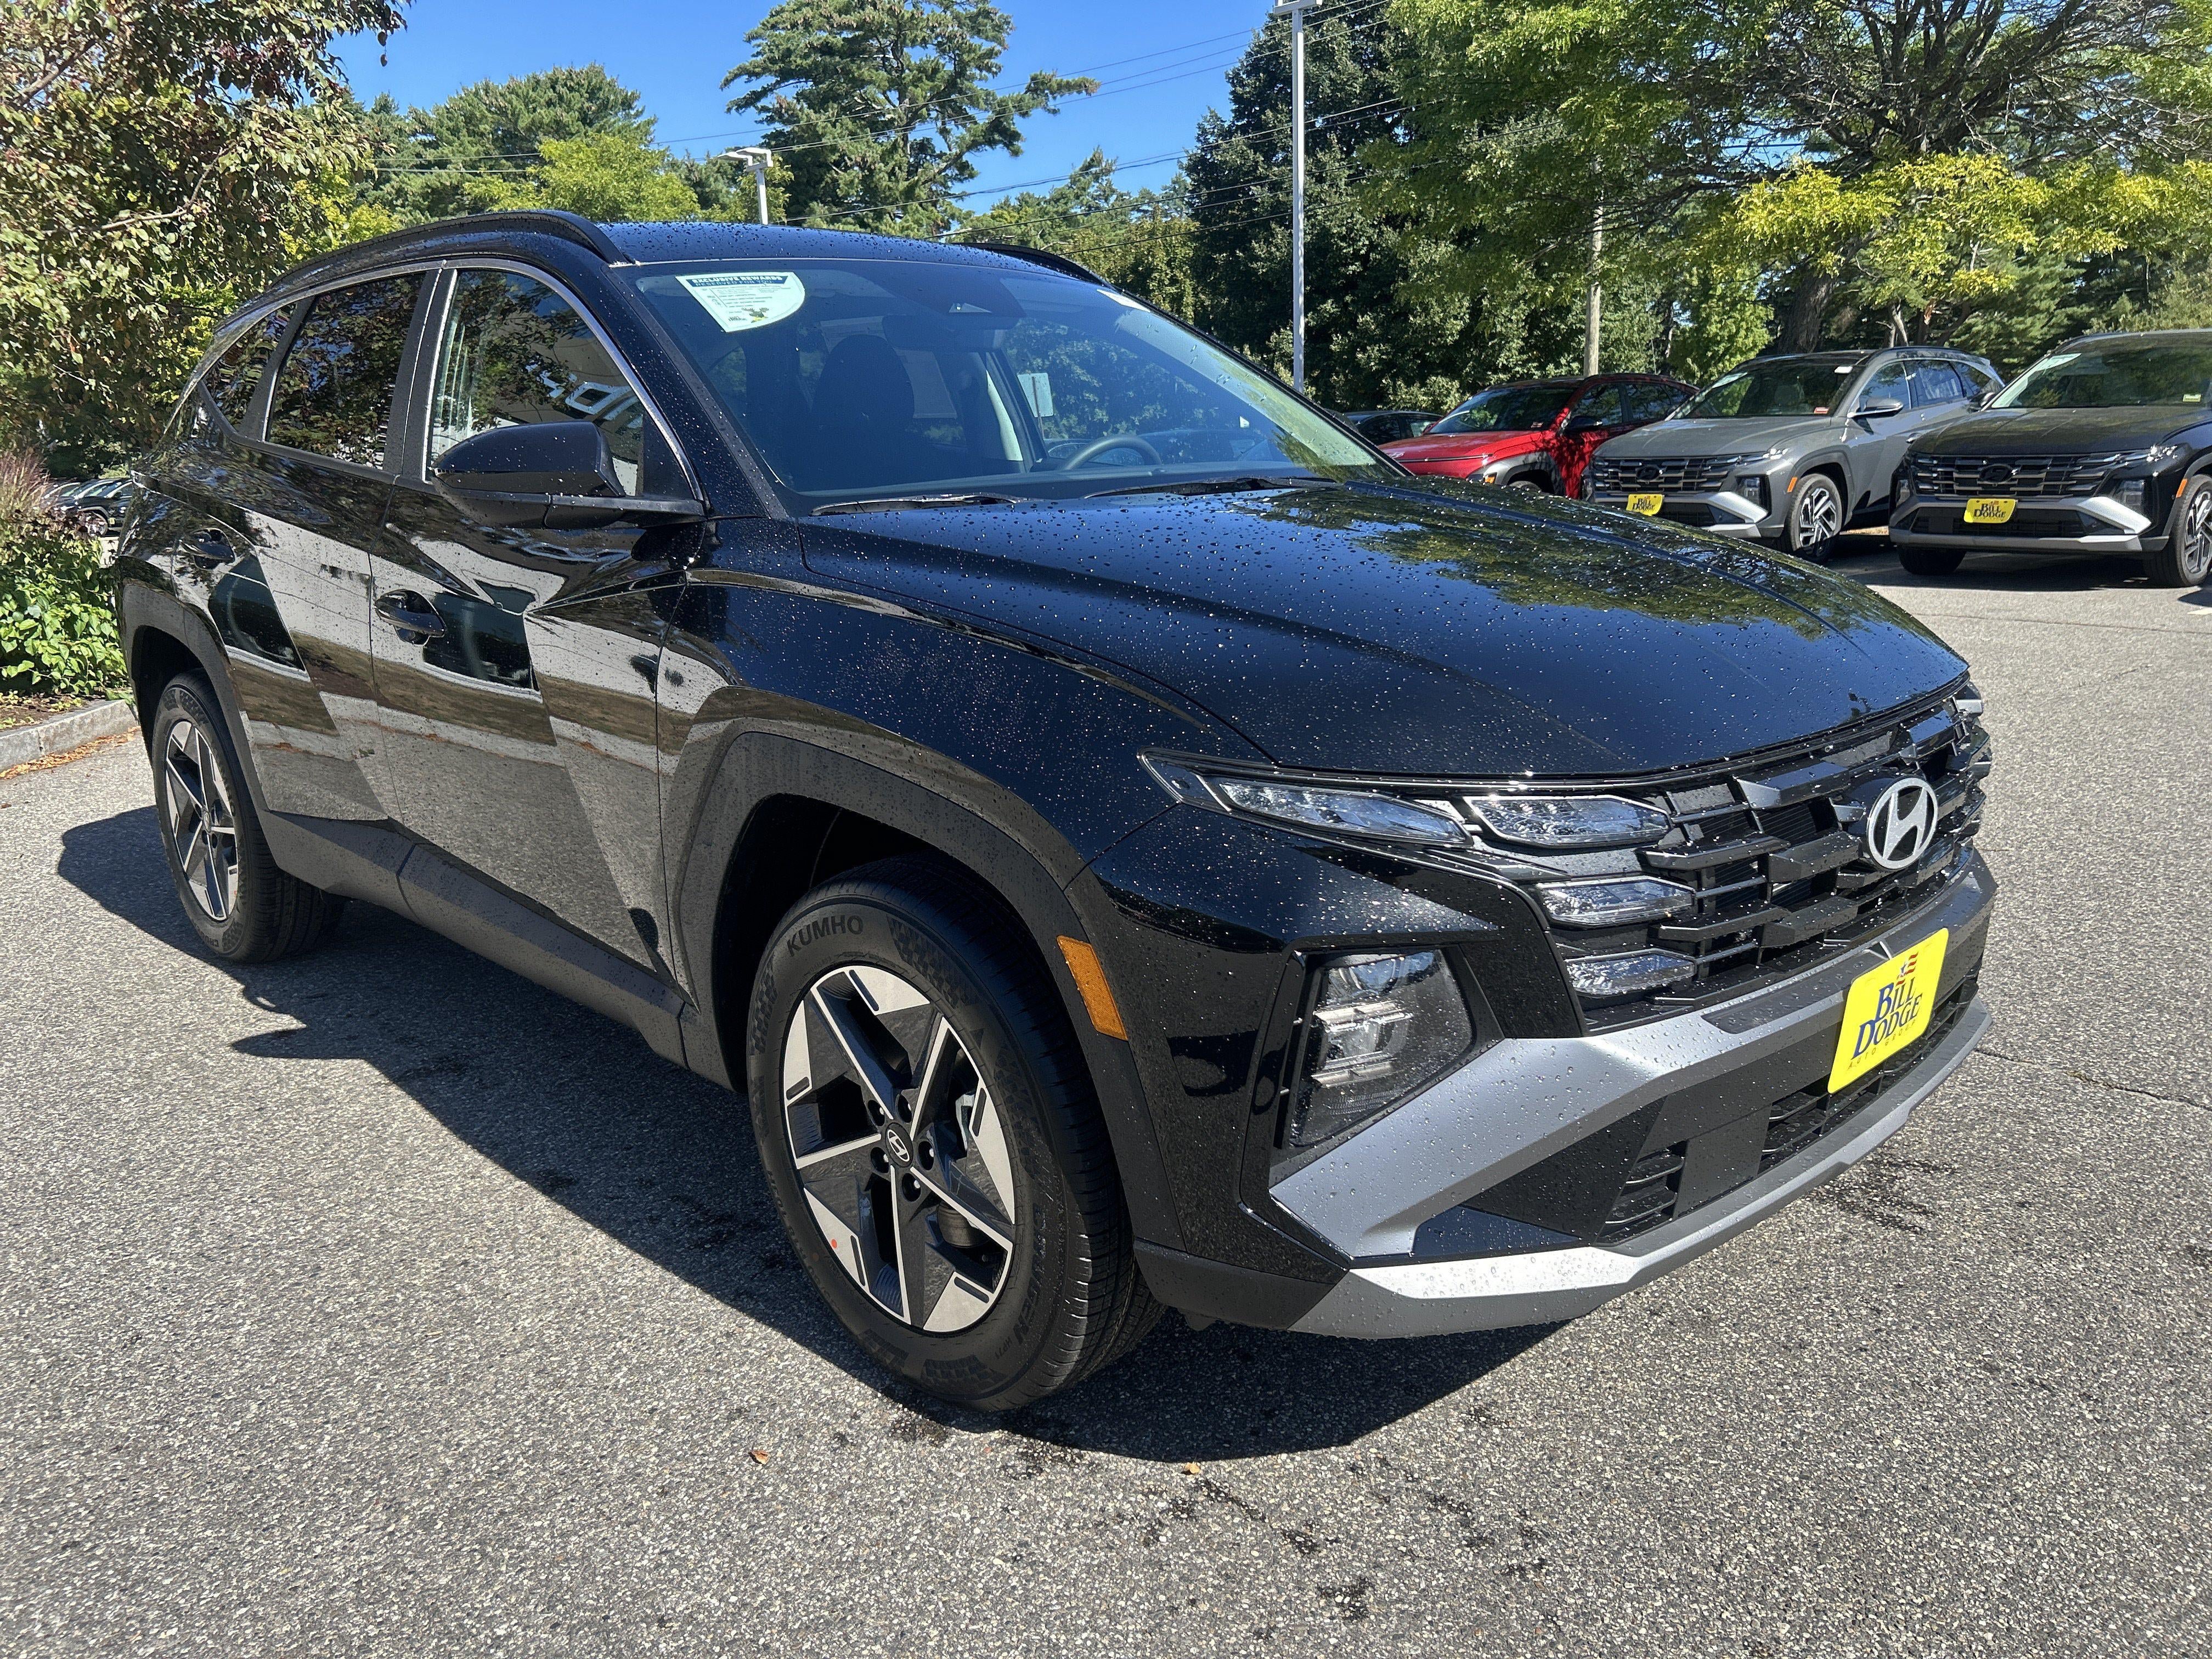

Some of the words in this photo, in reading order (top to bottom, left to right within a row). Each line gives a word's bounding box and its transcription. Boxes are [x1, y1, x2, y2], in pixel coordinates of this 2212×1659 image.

[1974, 509, 2006, 518] DODGE
[1981, 504, 2001, 512] BILL
[787, 915, 864, 957] KUMHO
[1875, 977, 1916, 1022] BILL
[1850, 993, 1922, 1060] DODGE
[1847, 1047, 1876, 1070] AUTO
